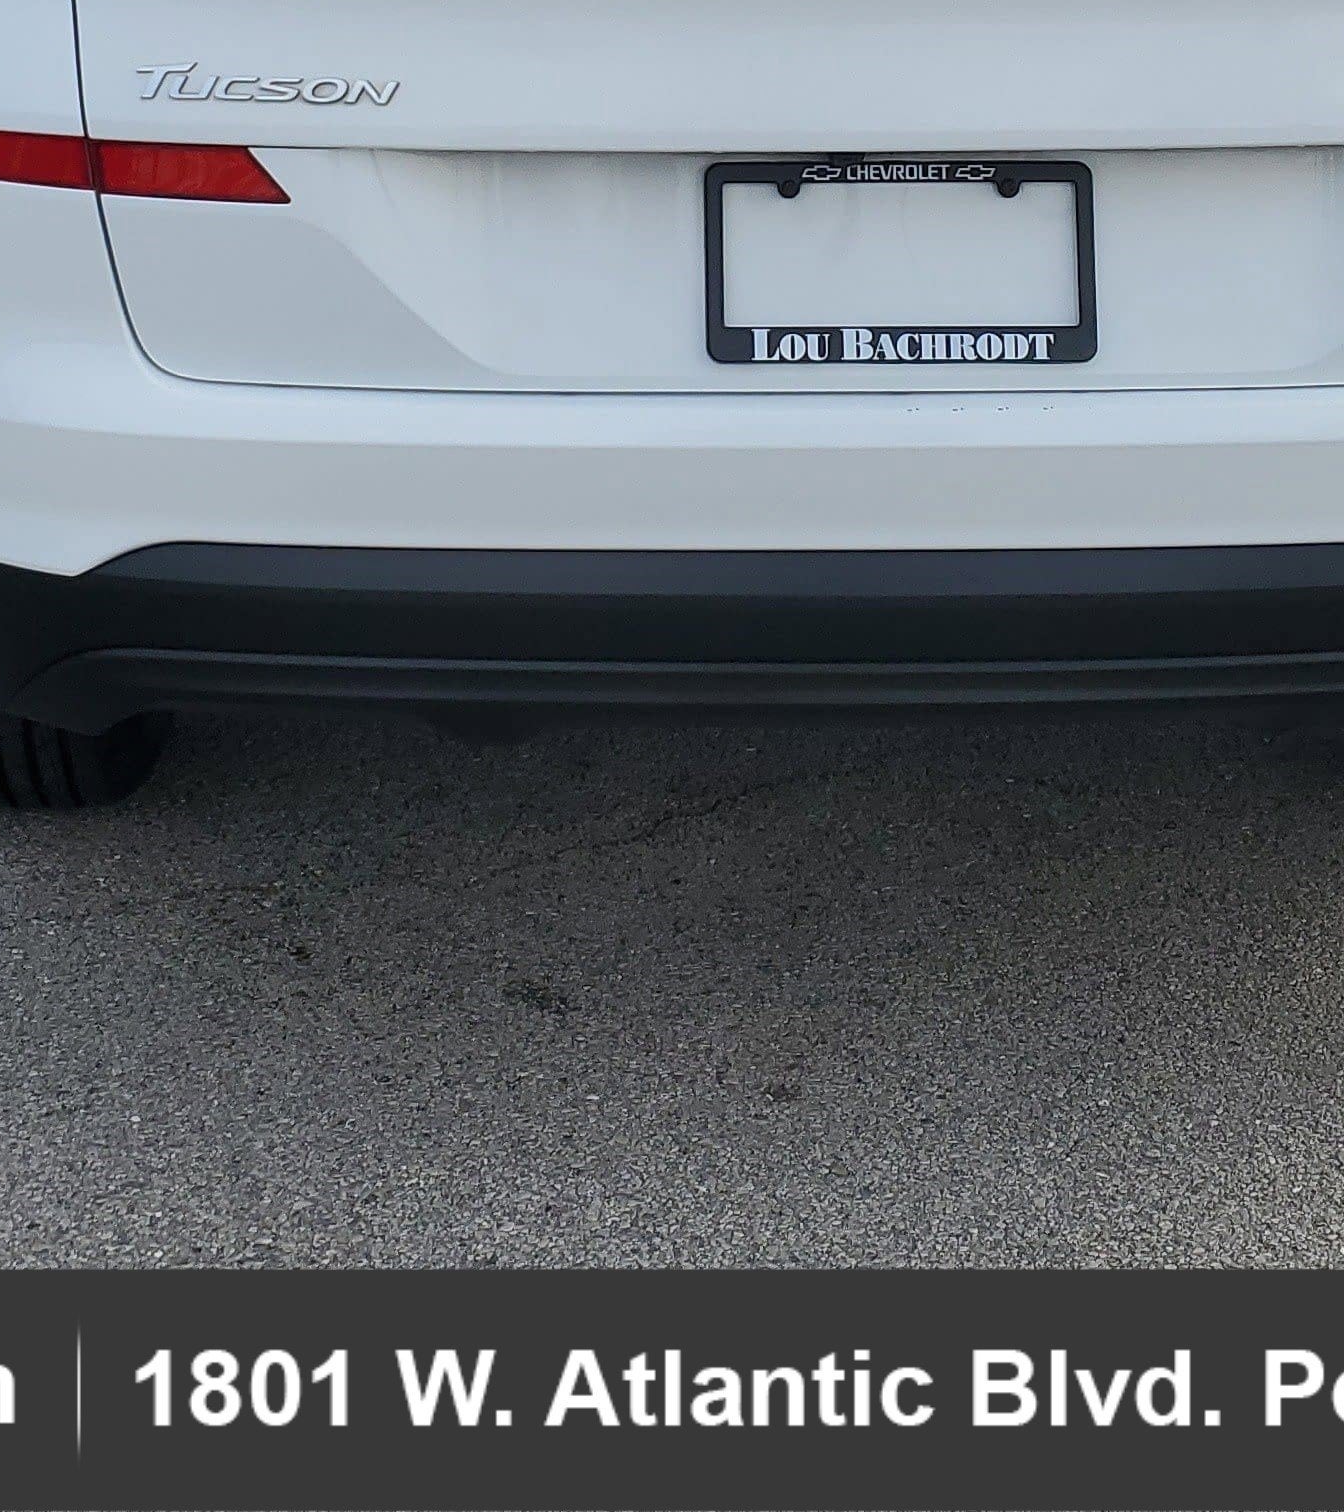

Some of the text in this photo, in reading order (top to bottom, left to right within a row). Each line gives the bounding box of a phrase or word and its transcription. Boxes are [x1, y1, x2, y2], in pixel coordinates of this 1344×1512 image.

[136, 62, 401, 106] TUCSON
[846, 163, 950, 181] CHEVROLET
[751, 328, 1056, 362] LOU BACHRODT
